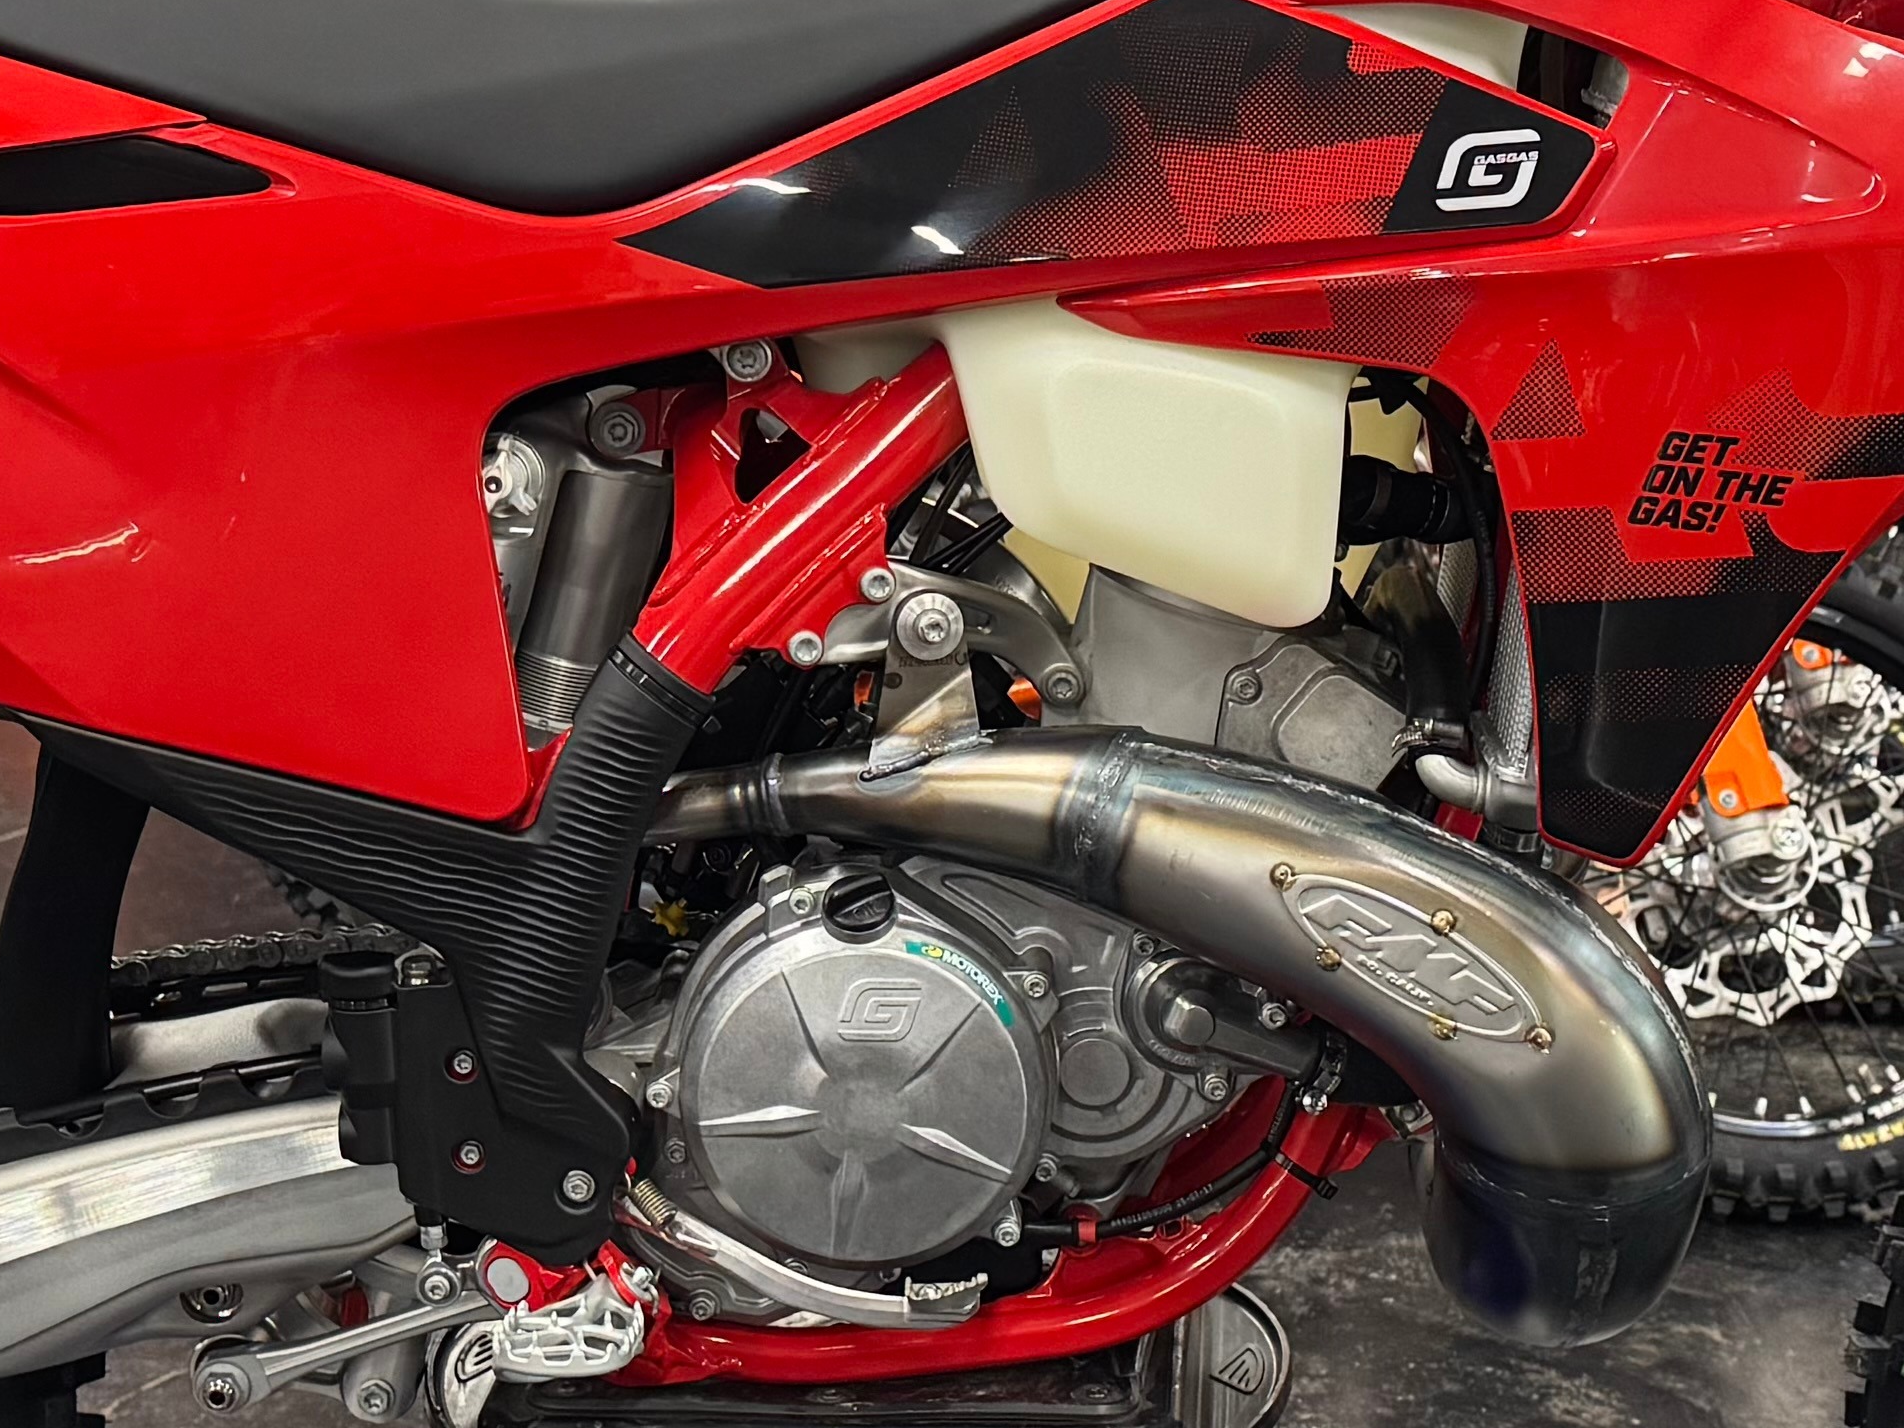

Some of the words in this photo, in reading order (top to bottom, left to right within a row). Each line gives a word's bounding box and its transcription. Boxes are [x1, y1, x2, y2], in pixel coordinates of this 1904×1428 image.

[1473, 151, 1539, 165] GASGAS
[1657, 430, 1741, 467] GET
[1641, 463, 1706, 498] ON
[1714, 469, 1795, 507] THE
[1627, 495, 1727, 534] GAS!
[1299, 894, 1515, 1016] FMF
[942, 948, 1004, 1006] MOTOREX
